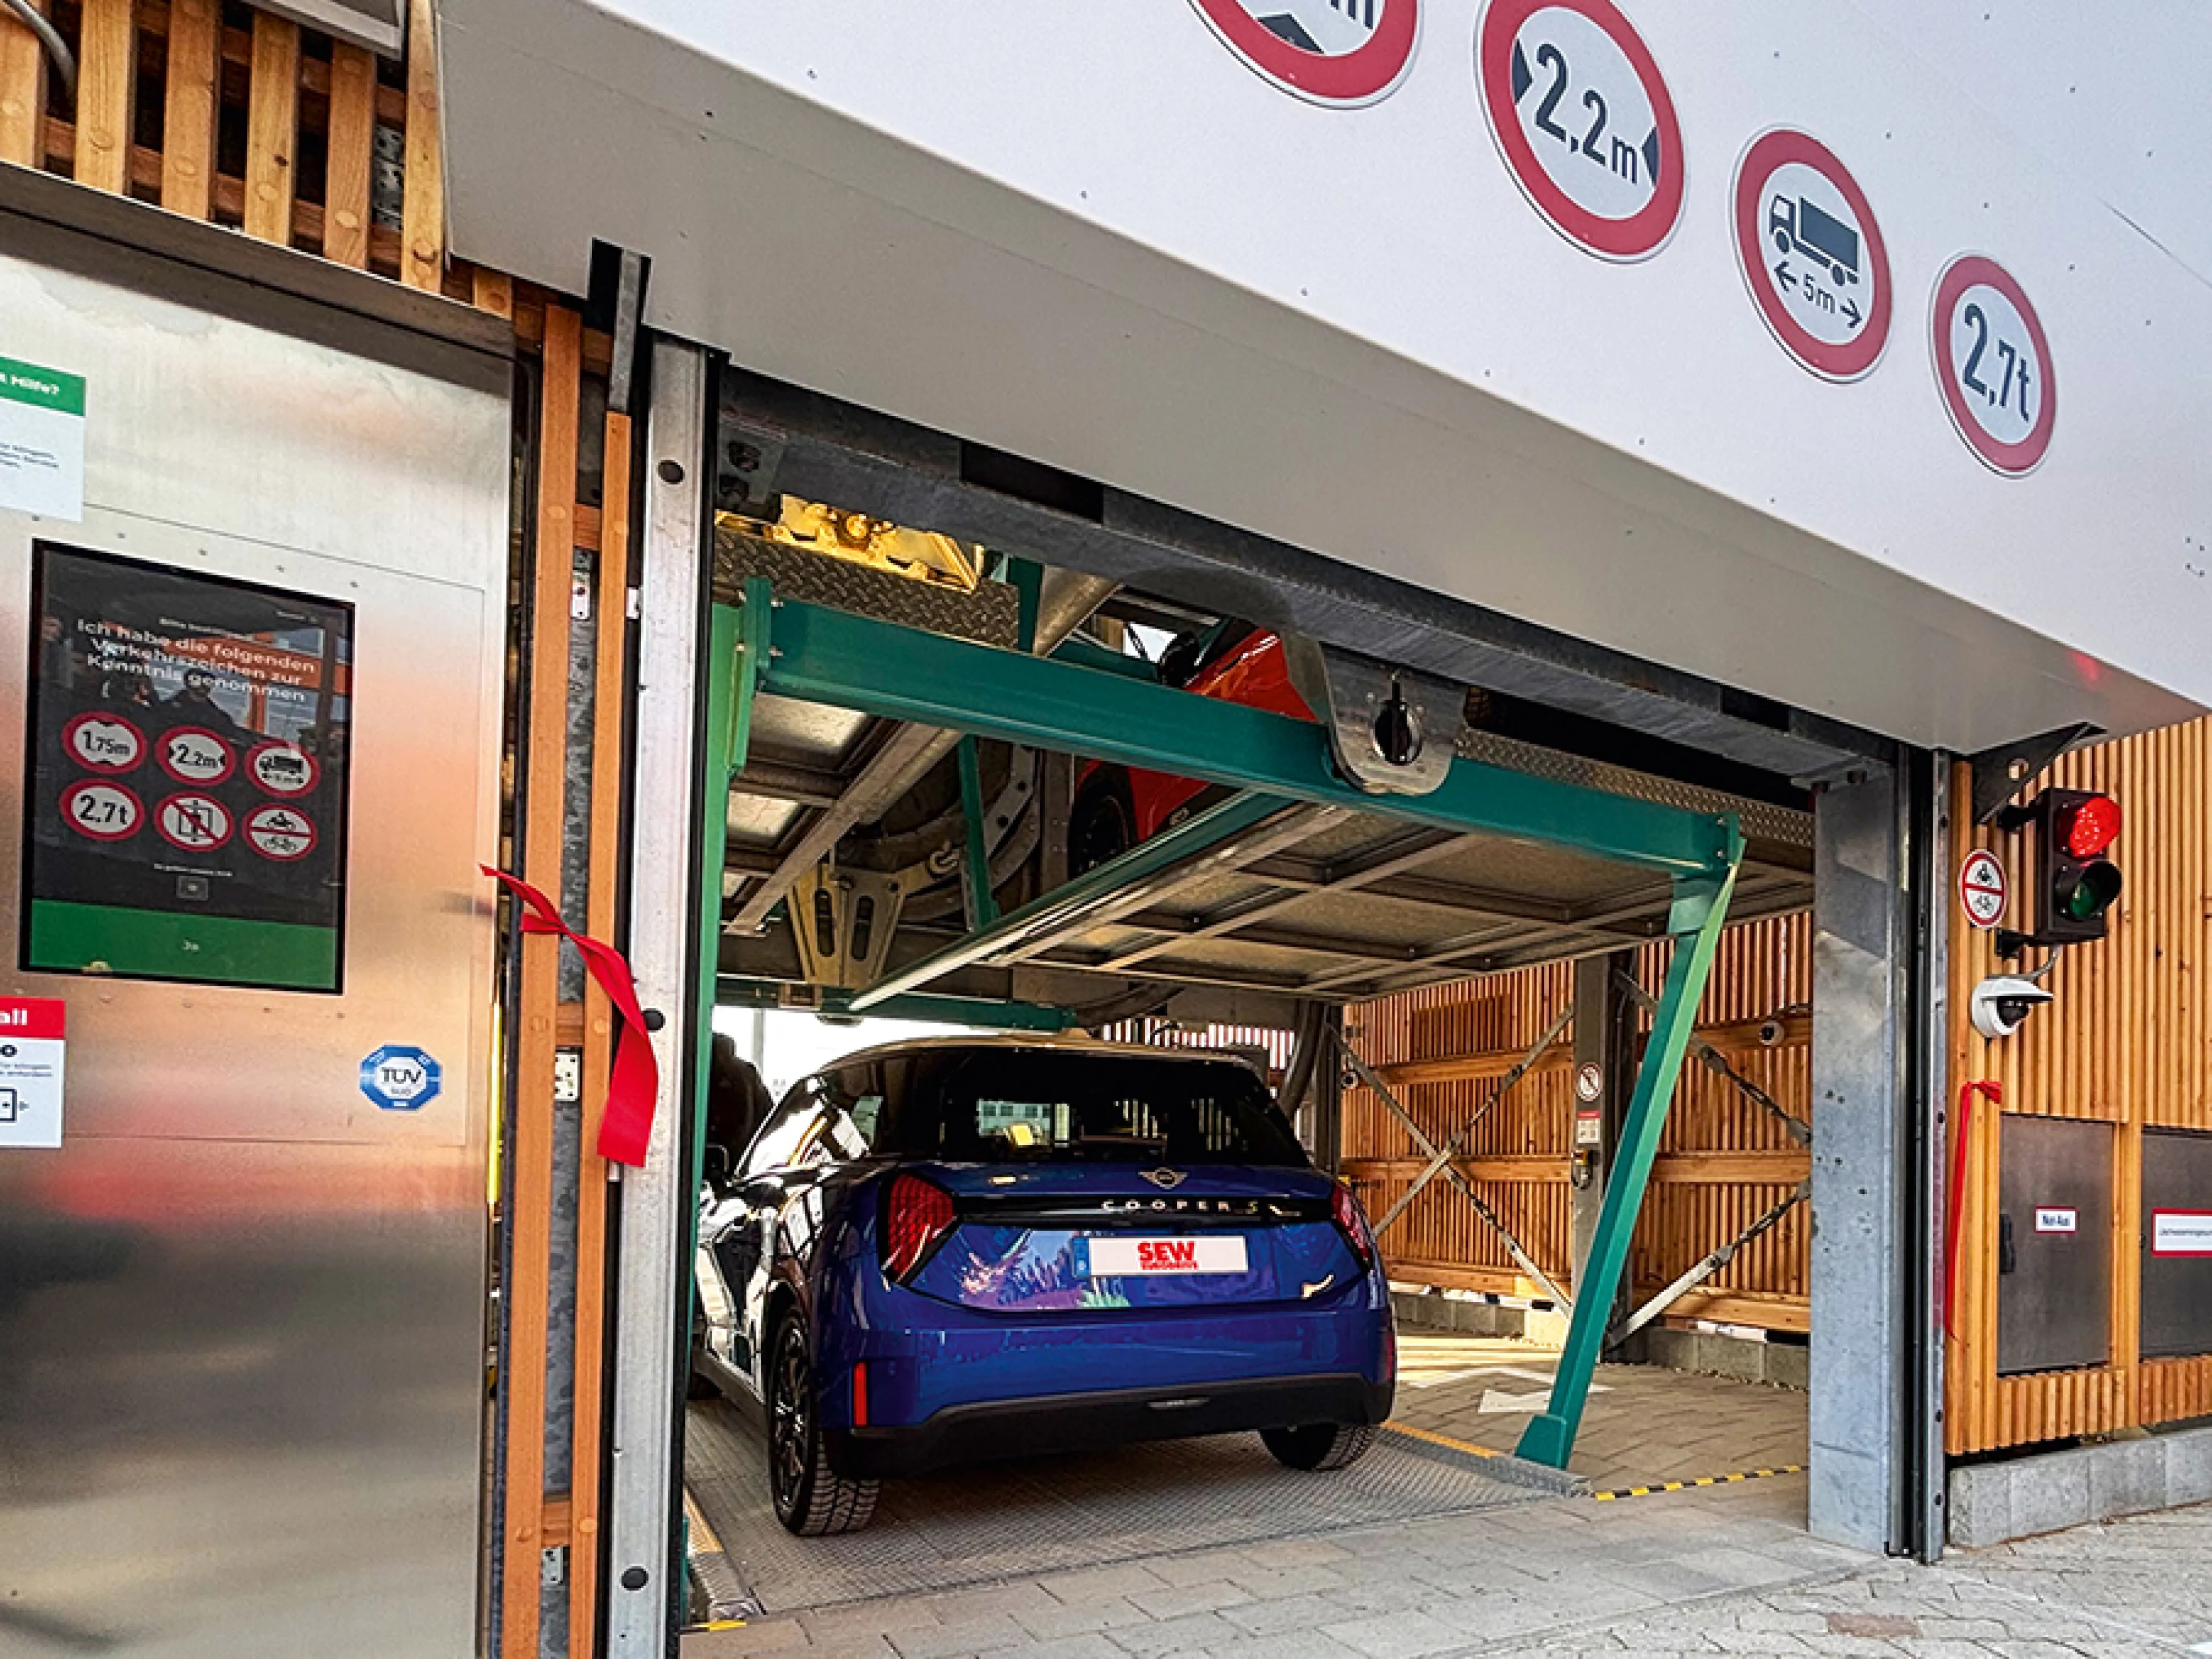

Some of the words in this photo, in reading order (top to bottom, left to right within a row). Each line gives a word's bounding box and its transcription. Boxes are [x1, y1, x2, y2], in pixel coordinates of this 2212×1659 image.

[1536, 43, 1637, 184] 2,2m
[1804, 272, 1836, 313] 5m
[1964, 303, 2030, 422] 2,7t
[78, 619, 110, 634] Ich
[118, 627, 171, 646] habe
[176, 638, 208, 653] die
[213, 642, 315, 673] folgenden
[92, 638, 265, 679] Verkehrszeichen
[271, 672, 302, 685] zur
[88, 653, 184, 680] Kenntnis
[188, 675, 305, 702] genommen
[1101, 1199, 1230, 1212] COOPER
[1137, 1240, 1196, 1261] SEW
